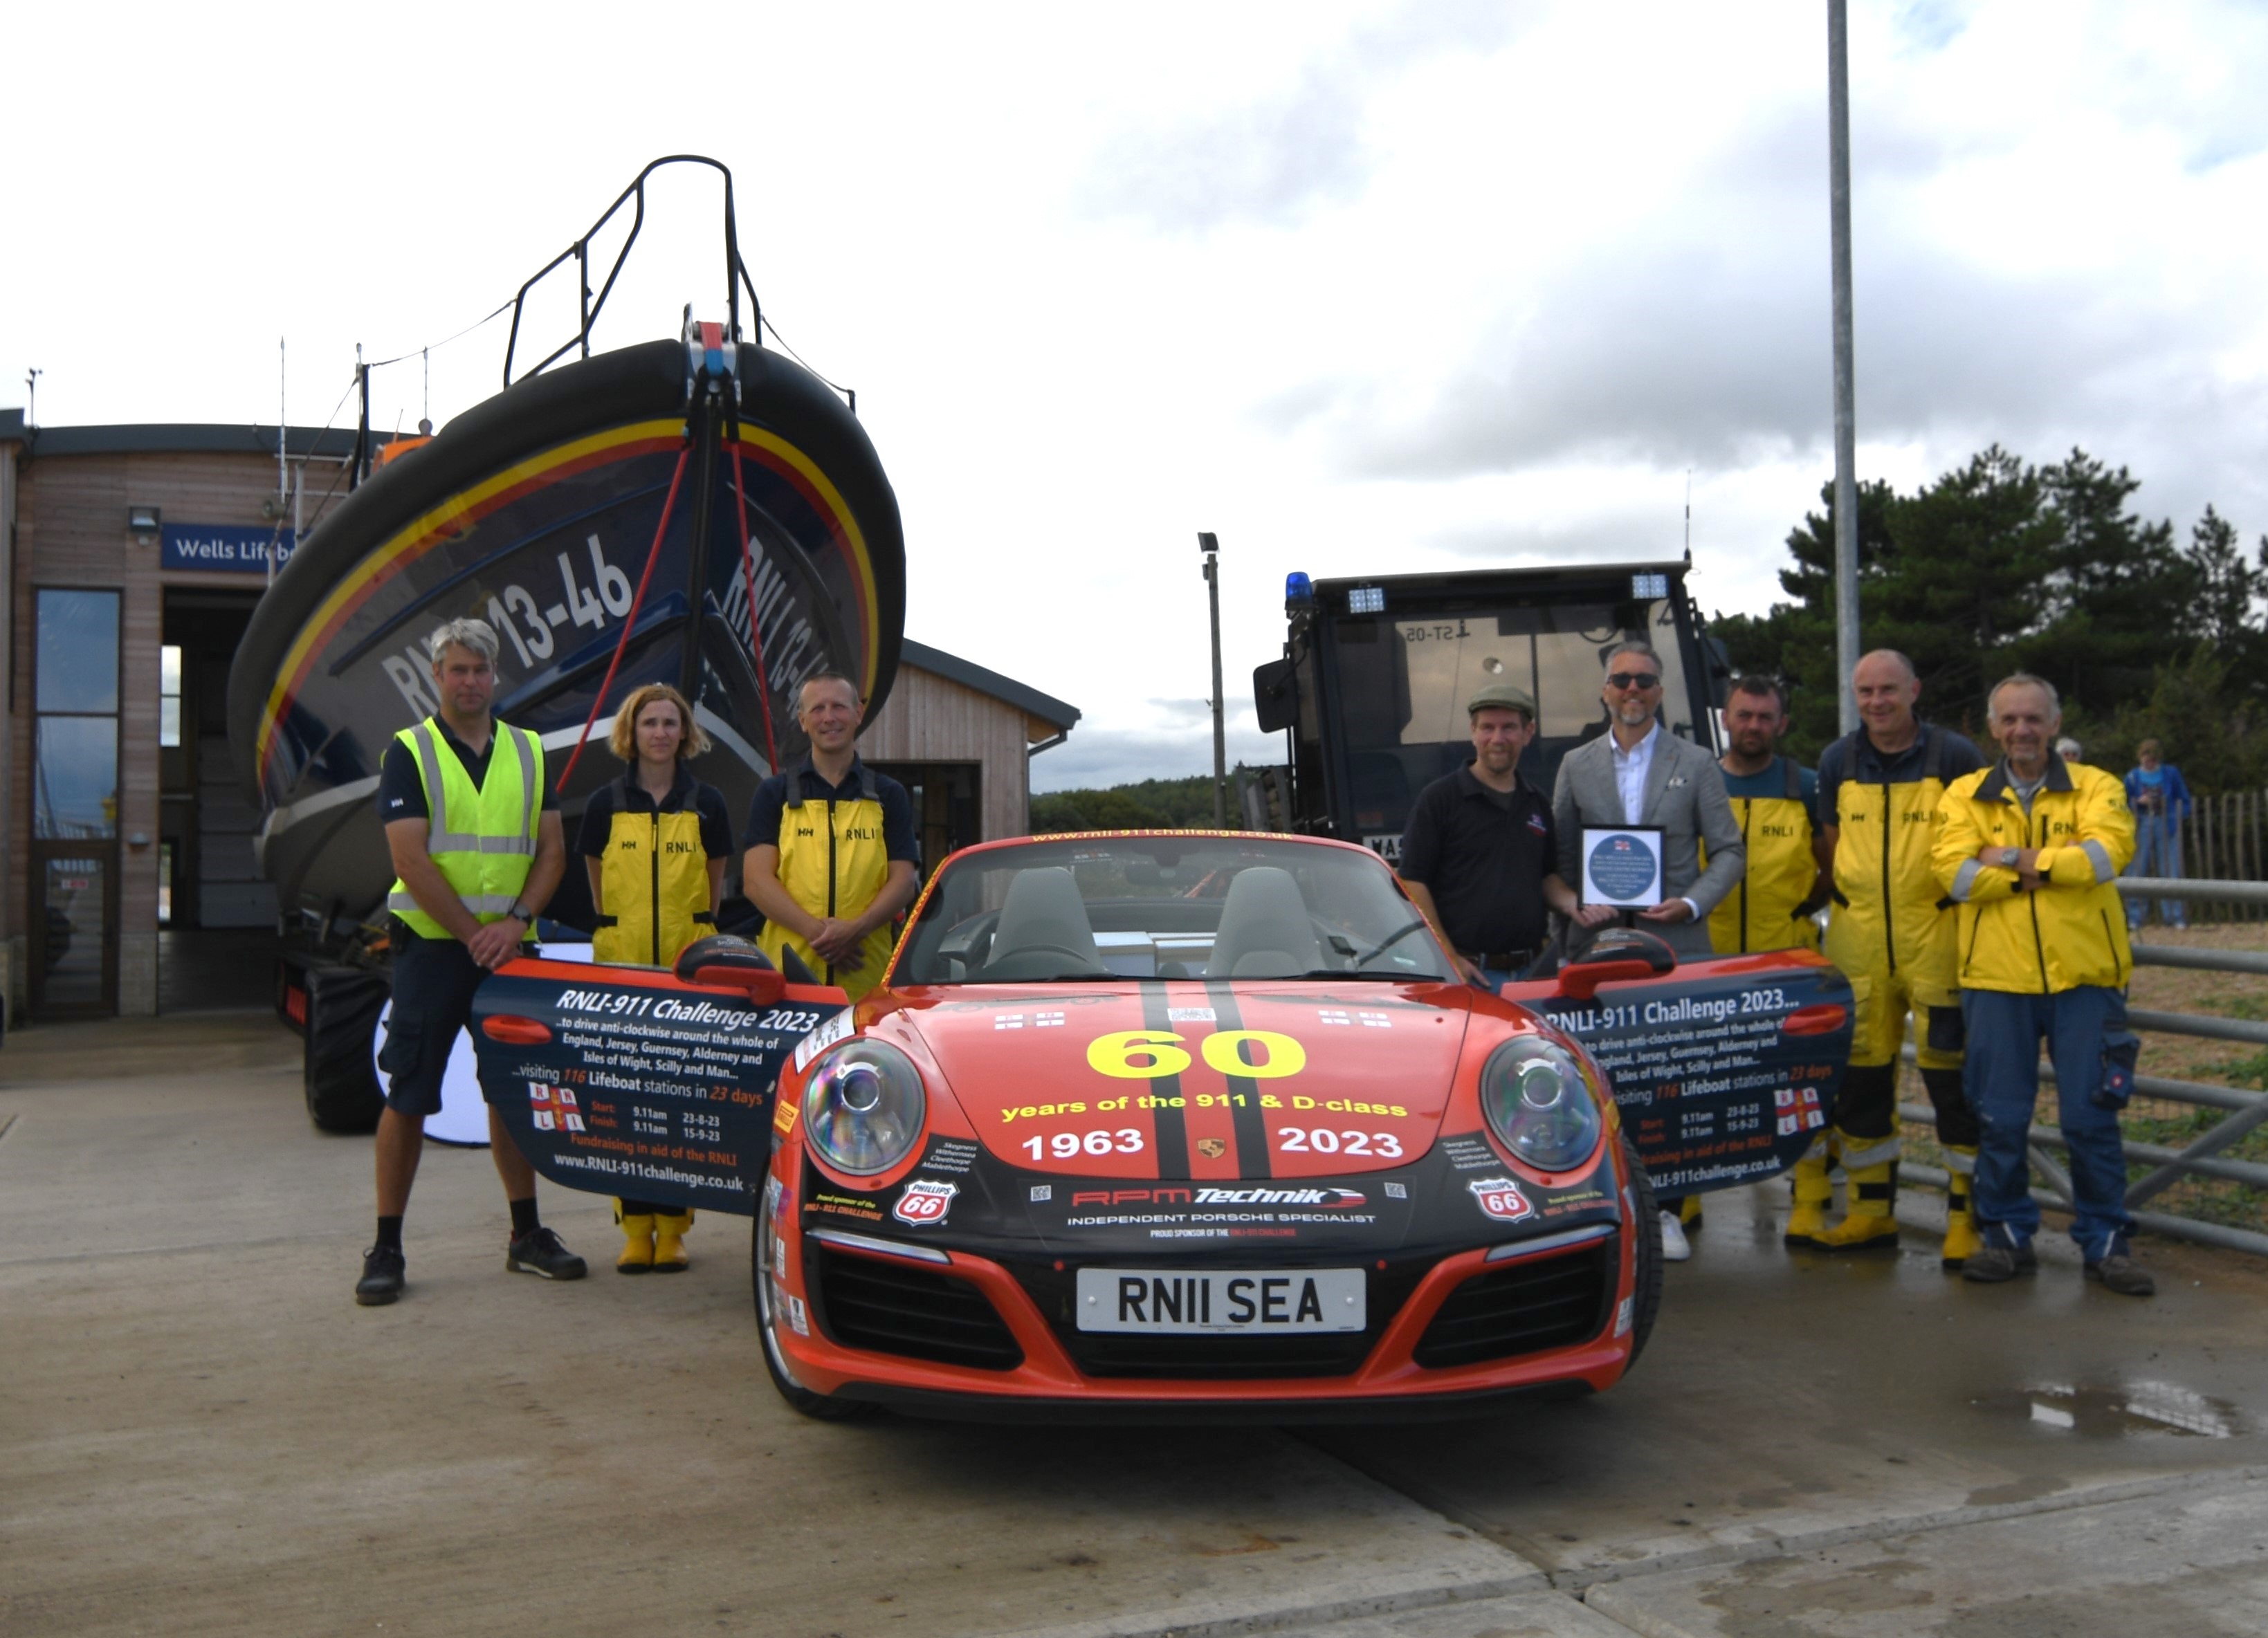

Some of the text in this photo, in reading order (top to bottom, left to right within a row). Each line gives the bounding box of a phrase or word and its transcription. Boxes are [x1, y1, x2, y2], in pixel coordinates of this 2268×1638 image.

[176, 539, 235, 559] Wells
[488, 533, 633, 669] 13-46
[845, 828, 875, 841] RNLI
[1032, 829, 1293, 842] www.rnli-911challenge.co.uk
[1762, 825, 1794, 838] RNLI
[666, 842, 697, 853] RNLI
[556, 990, 653, 1017] RNLI-911
[652, 1000, 758, 1031] Challenge
[1644, 997, 1737, 1024] Challenge
[1740, 988, 1800, 1013] 2023...
[574, 1019, 598, 1031] drive
[601, 1022, 670, 1039] anti-clockwise
[673, 1029, 710, 1043] around
[712, 1033, 729, 1045] the
[732, 1036, 764, 1049] whole
[766, 1038, 780, 1049] of
[1599, 1039, 1625, 1051] drive
[1627, 1029, 1694, 1048] anti-clockwise
[1696, 1024, 1730, 1040] around
[1730, 1022, 1747, 1036] the
[1748, 1019, 1775, 1033] whole
[563, 1032, 762, 1065] England, Jersey, Guernsey, Alderney and
[1086, 1029, 1306, 1078] 60
[1637, 1050, 1669, 1063] Jersey,
[1670, 1045, 1717, 1060] Guernsey,
[1718, 1039, 1759, 1052] Alderney
[1760, 1035, 1778, 1047] and
[583, 1051, 739, 1079] Isles of Wight, Scilly and Man...
[1616, 1071, 1638, 1083] Isles
[1640, 1068, 1651, 1080] of
[1652, 1063, 1685, 1079] Wight,
[1686, 1059, 1712, 1074] Scilly
[1713, 1057, 1731, 1070] and
[512, 1063, 764, 1108] ...visiting 116 Lifeboat stations in 23 days
[1656, 1083, 1679, 1100] 116
[1681, 1077, 1730, 1097] Lifeboat
[1733, 1073, 1775, 1089] stations
[1777, 1069, 1789, 1083] in
[1807, 1065, 1832, 1080] days
[592, 1101, 720, 1128] Start: 9.11am 23-8-23
[1001, 1093, 1409, 1123] years of the 911 & D-class
[1681, 1112, 1714, 1125] 9.11am
[590, 1114, 721, 1142] Finish: 9.11am 15-9-23
[1681, 1126, 1713, 1139] 9.11am
[571, 1133, 738, 1166] Fundraising in aid of the RNLI
[943, 1141, 977, 1152] Skegness
[1021, 1127, 1403, 1161] 1963 2023
[1683, 1147, 1694, 1160] in
[1696, 1143, 1714, 1158] aid
[554, 1154, 744, 1191] www.RNLI-911challenge.co.uk
[913, 1184, 951, 1195] PHILLIPS
[1194, 1188, 1323, 1204] Technik
[1488, 1193, 1520, 1212] 66
[837, 1205, 884, 1221] CHALLENGE
[904, 1196, 941, 1215] 66
[1067, 1213, 1377, 1226] INDEPENDENT PORSCHE SPECIALIST
[1150, 1228, 1297, 1237] PROUD SPONSOR OF THE RNLI-911 CHALLENGE
[1227, 1278, 1323, 1323] SEA
